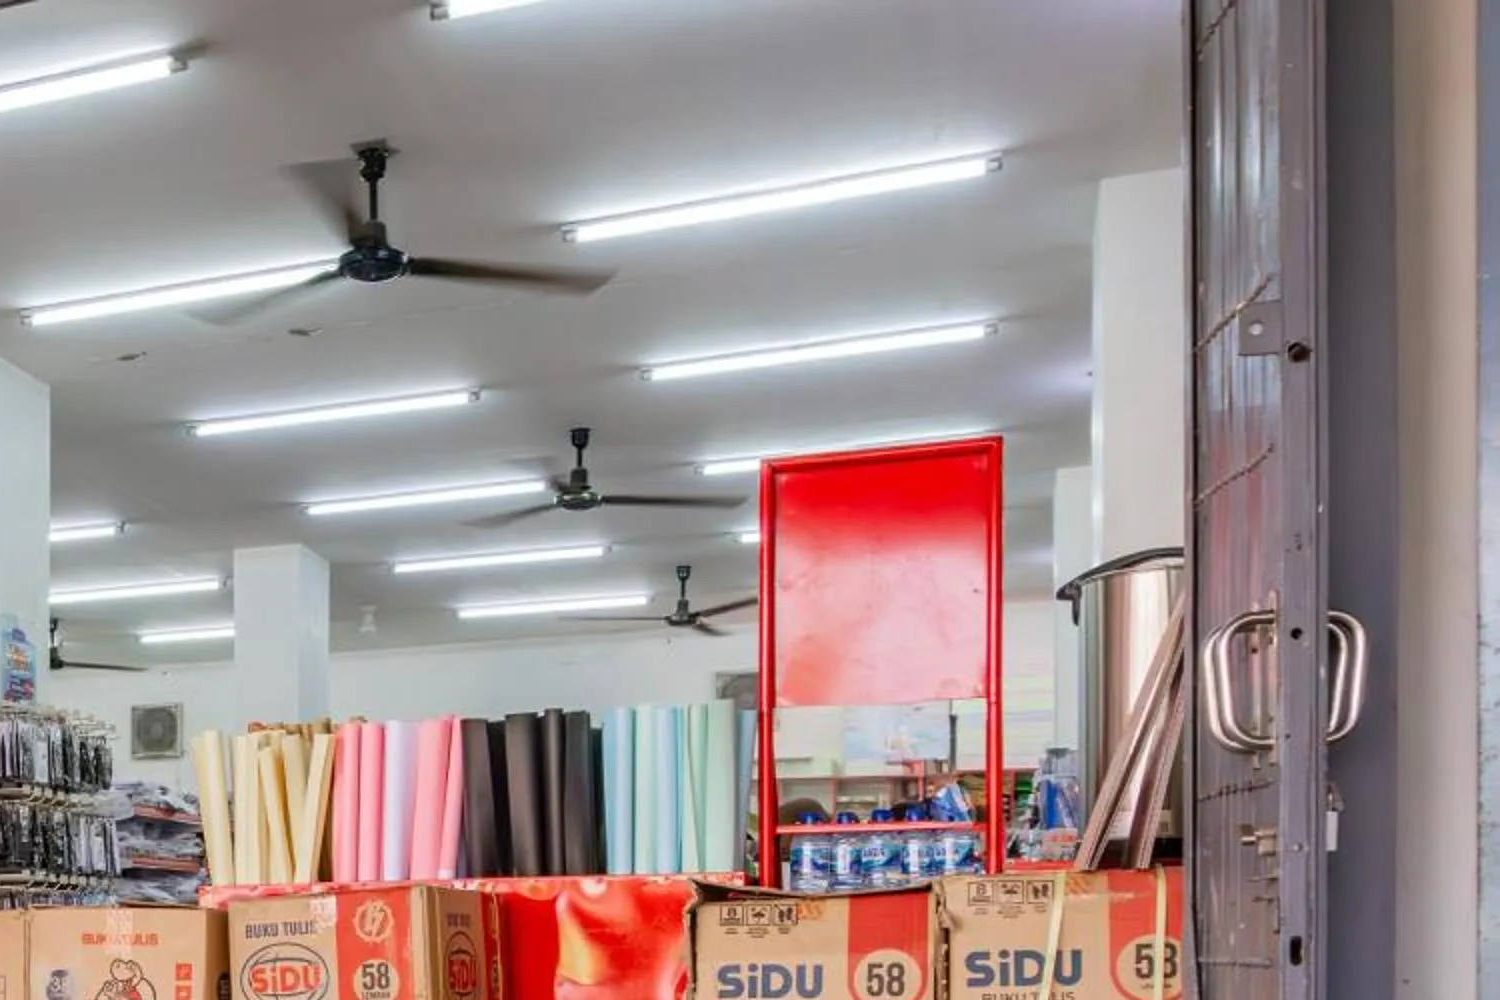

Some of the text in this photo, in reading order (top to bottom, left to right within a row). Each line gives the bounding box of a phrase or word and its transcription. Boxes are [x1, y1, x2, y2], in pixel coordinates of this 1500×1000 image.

[245, 923, 278, 939] BUKU
[250, 963, 321, 993] SiDU
[361, 962, 390, 990] 58
[964, 949, 1082, 988] SiDU
[1135, 943, 1178, 979] 58
[717, 963, 823, 999] SiDU
[867, 962, 905, 997] 58
